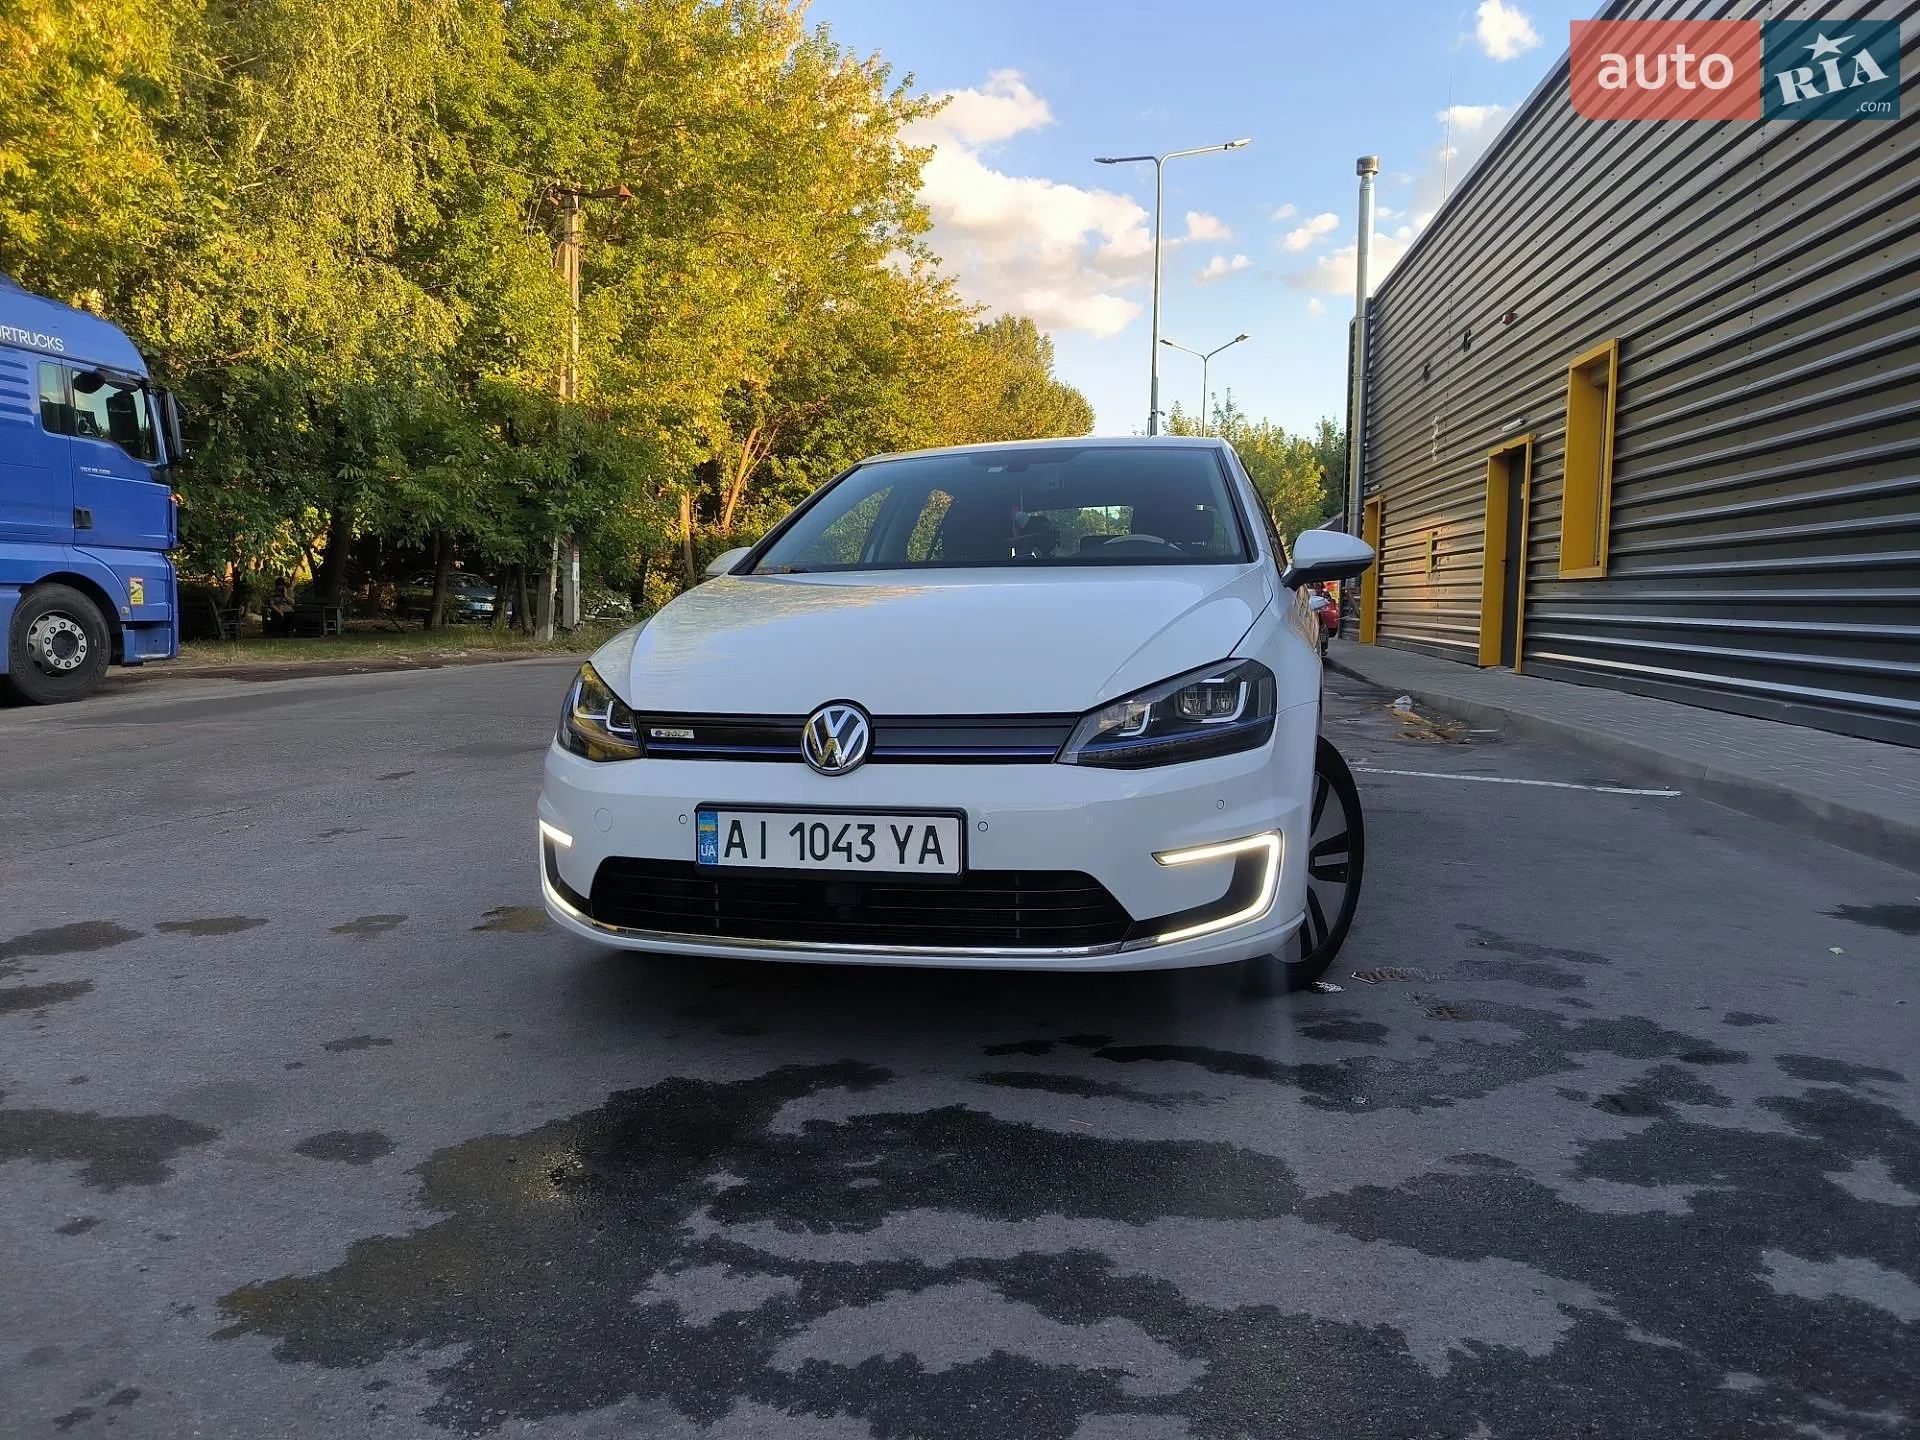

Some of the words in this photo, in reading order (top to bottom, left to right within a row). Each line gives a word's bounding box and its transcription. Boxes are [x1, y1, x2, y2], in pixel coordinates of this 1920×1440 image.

[0, 325, 65, 352] RTRUCKS
[700, 844, 717, 857] UA
[724, 819, 766, 859] AI
[789, 821, 876, 863] 1043
[890, 824, 945, 865] YA
